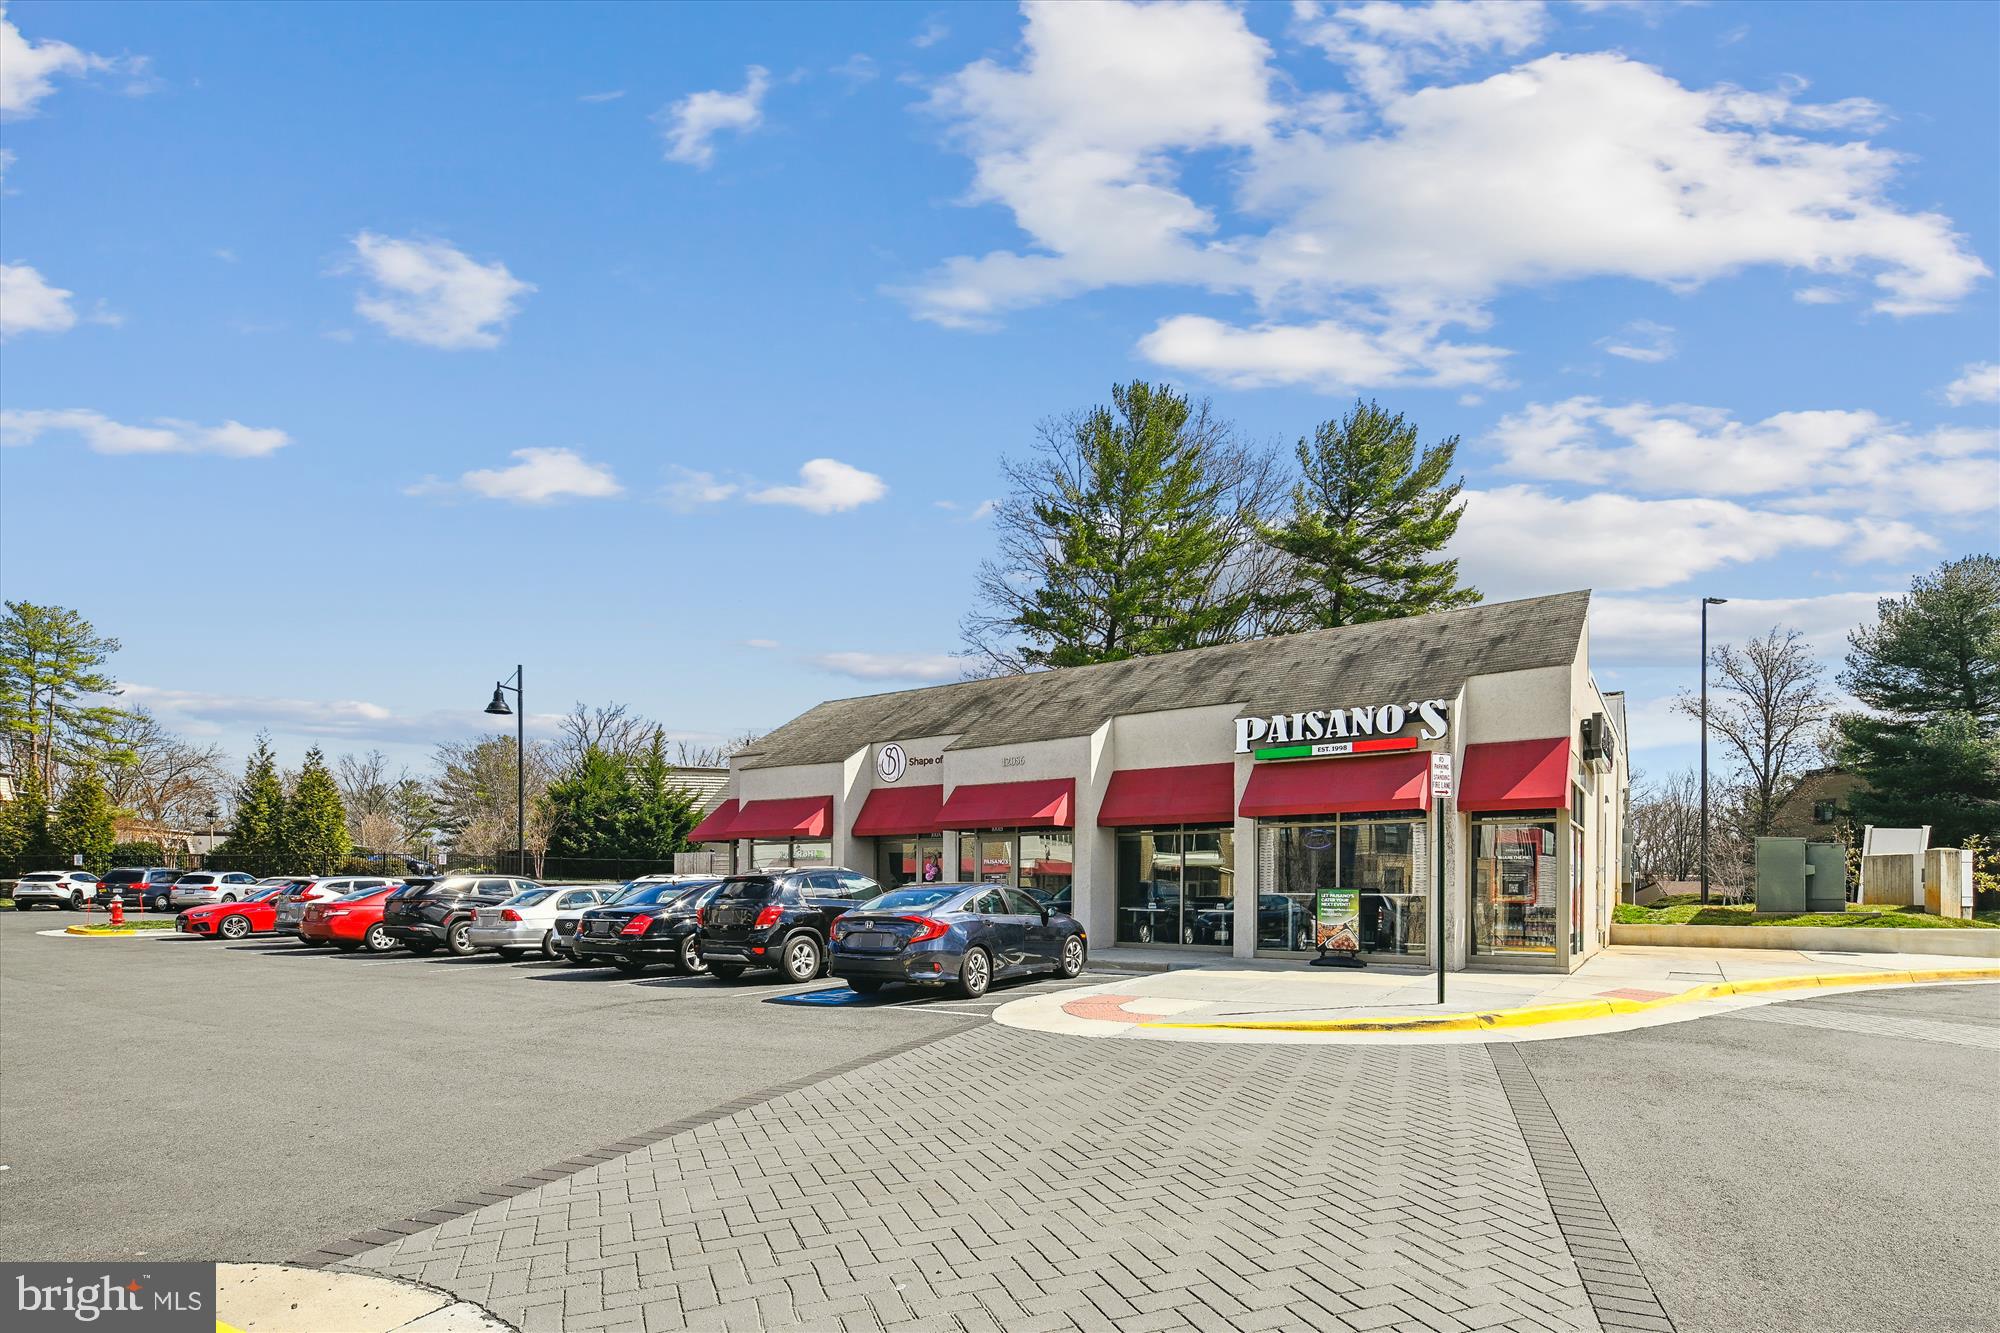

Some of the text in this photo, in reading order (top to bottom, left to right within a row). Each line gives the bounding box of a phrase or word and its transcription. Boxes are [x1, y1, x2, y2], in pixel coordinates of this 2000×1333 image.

[1233, 699, 1449, 754] PAISANO'S
[909, 754, 944, 767] Shape of
